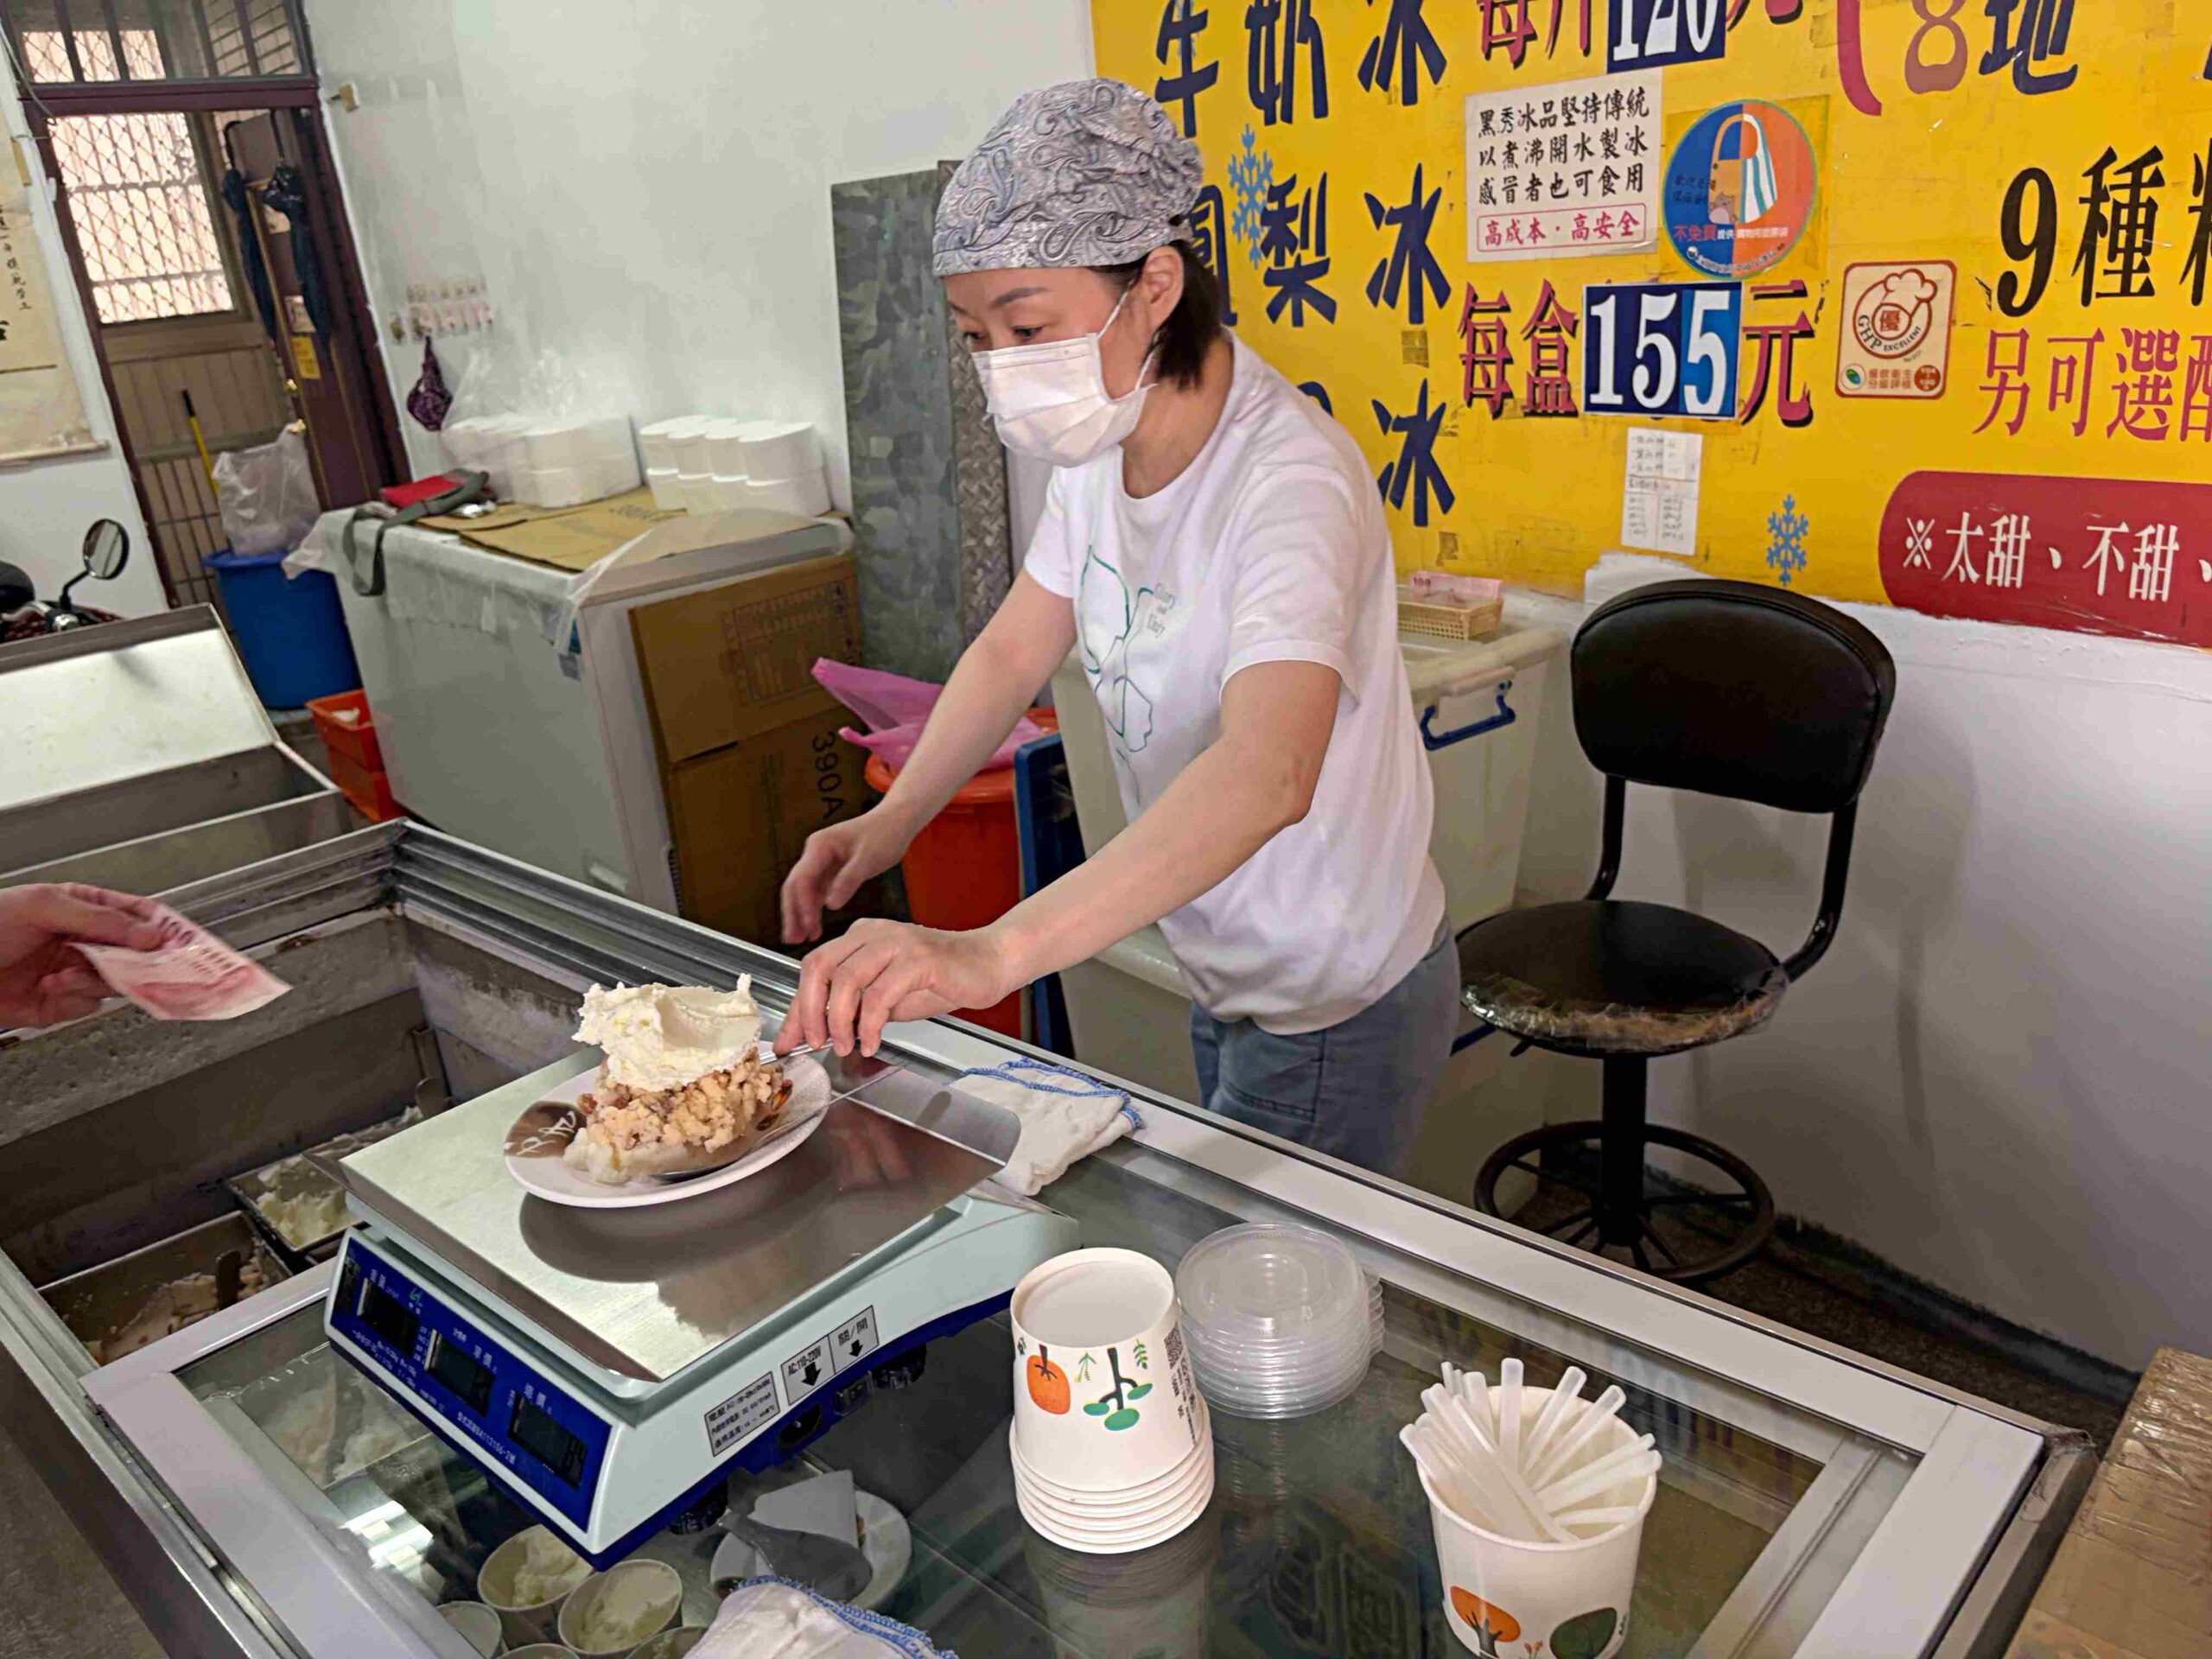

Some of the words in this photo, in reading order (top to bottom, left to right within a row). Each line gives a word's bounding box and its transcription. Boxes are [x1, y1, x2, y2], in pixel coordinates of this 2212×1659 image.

[1478, 86, 1649, 138] 黑秀冰品堅持傳統
[1479, 125, 1649, 169] 以煮沸開水製冰
[1478, 162, 1643, 207] 感冒者也可食用
[1858, 315, 1882, 351] GHP
[1883, 326, 1922, 353] EXCELLENT
[811, 731, 846, 820] 390A
